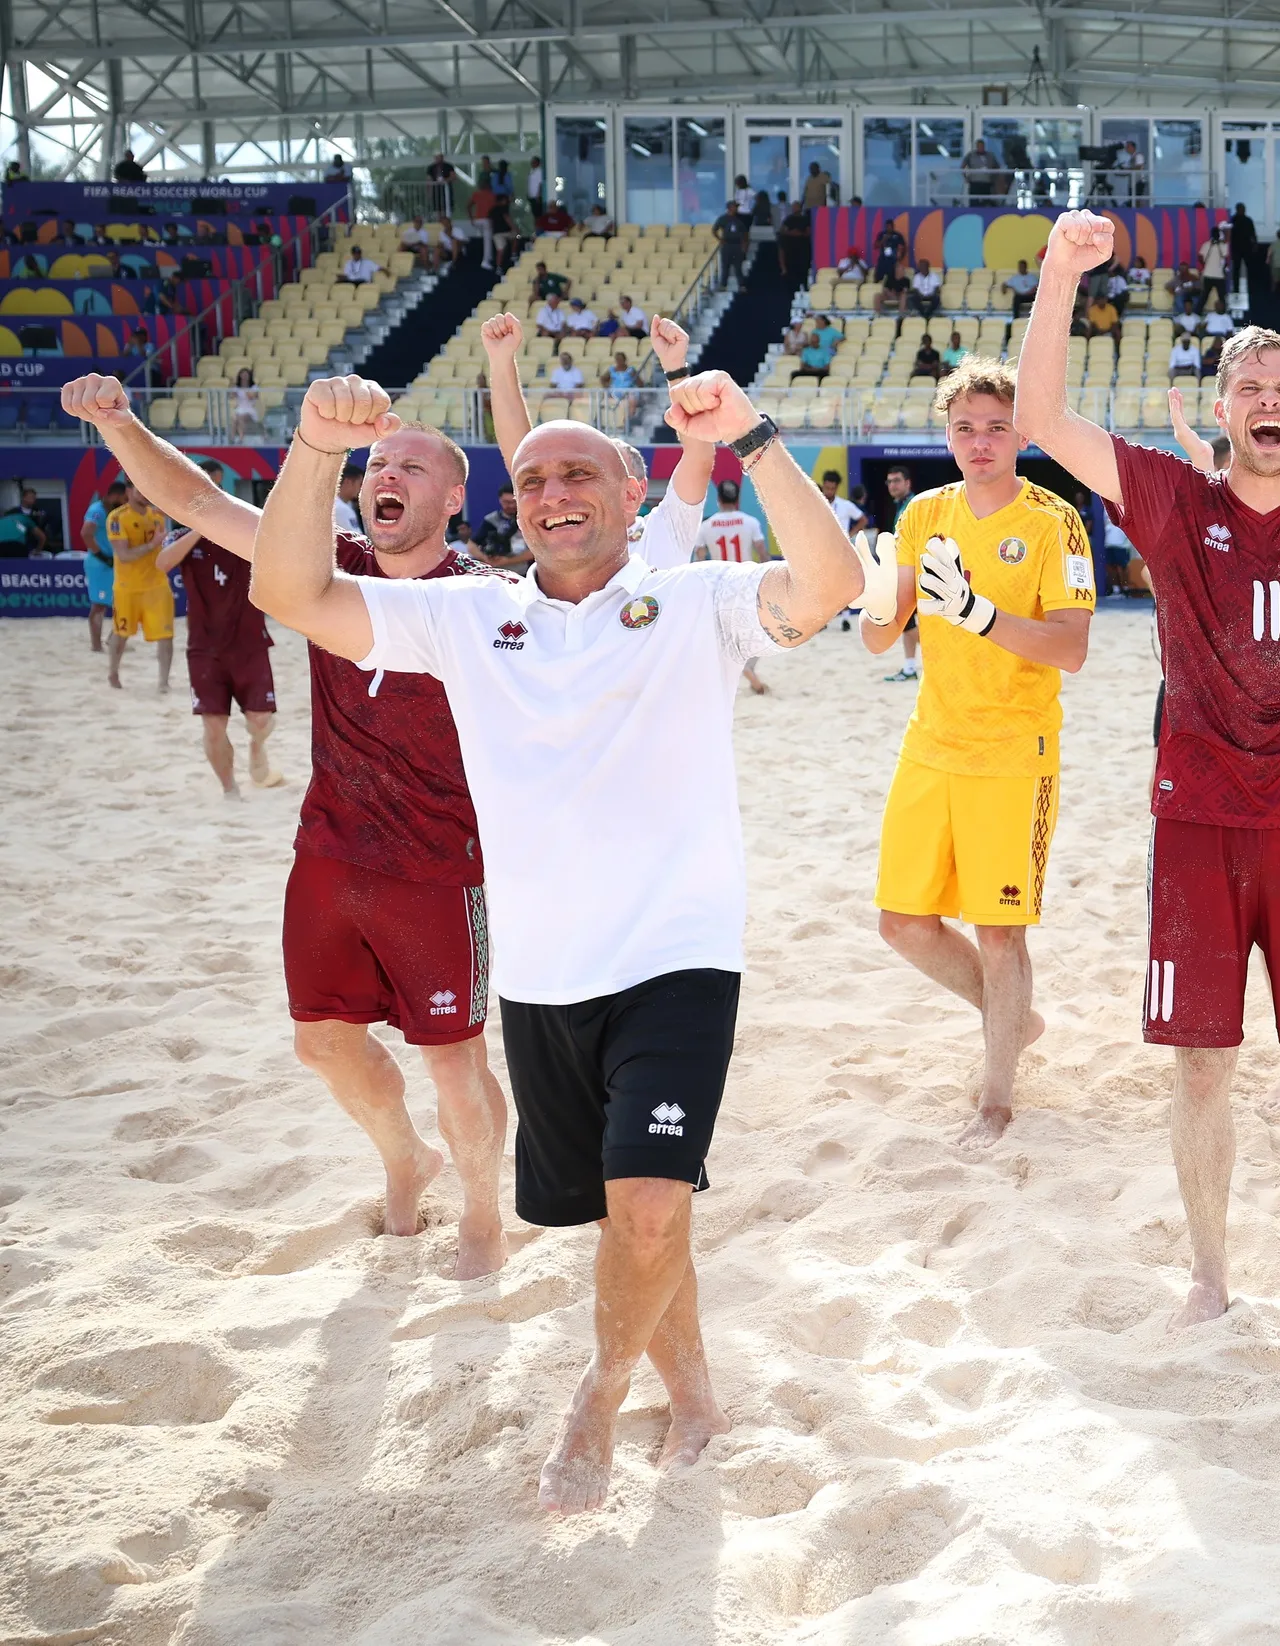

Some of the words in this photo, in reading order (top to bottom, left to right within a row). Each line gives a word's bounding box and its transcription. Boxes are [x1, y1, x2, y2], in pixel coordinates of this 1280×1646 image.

[83, 186, 110, 198] FIFA
[153, 186, 197, 198] SOCCER
[199, 186, 242, 198] WORLD
[244, 186, 269, 198] CUP
[15, 362, 45, 377] CUP
[715, 534, 742, 563] 11
[1, 573, 51, 588] BEACH
[214, 564, 228, 586] 4
[1150, 959, 1175, 1023] 11
